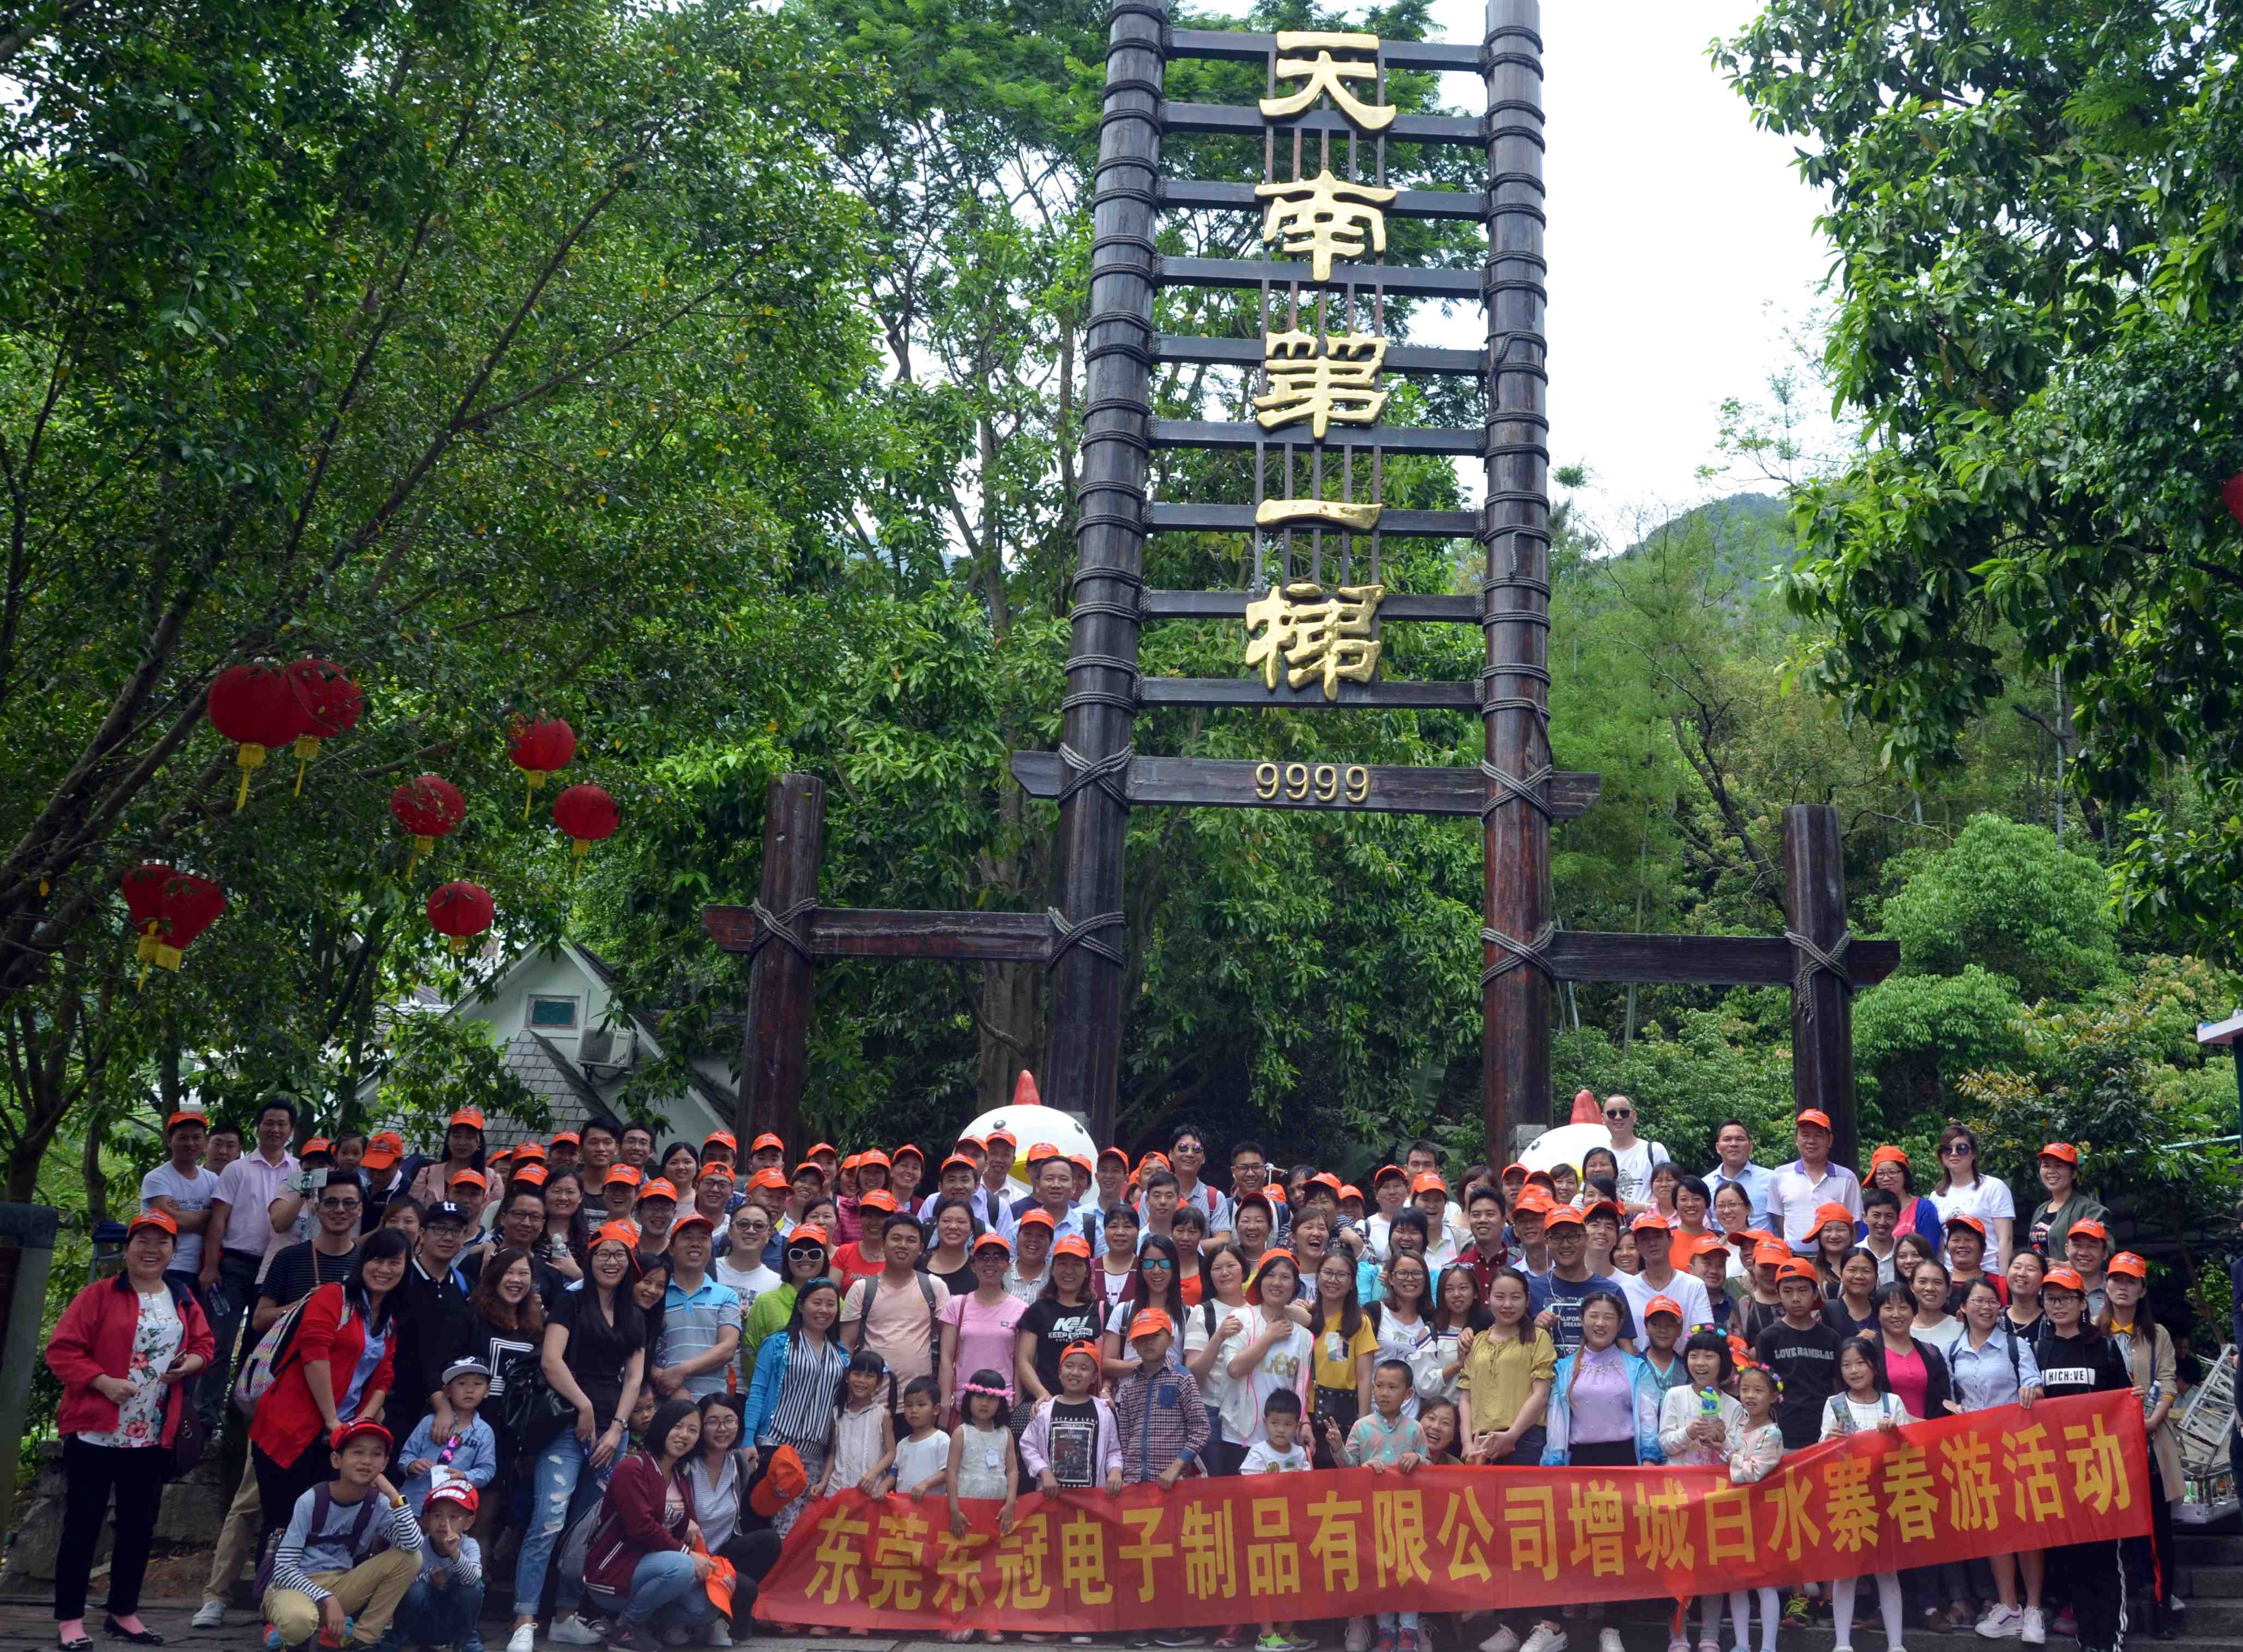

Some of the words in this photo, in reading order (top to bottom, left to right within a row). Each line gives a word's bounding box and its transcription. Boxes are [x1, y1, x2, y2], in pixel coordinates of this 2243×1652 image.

[1255, 762, 1371, 803] 9999
[1774, 1347, 1796, 1359] LOVE
[1797, 1347, 1834, 1360] RAMBLAS
[805, 1414, 2131, 1612] 东莞东冠电子制品有限公司增城白水寨春游活动
